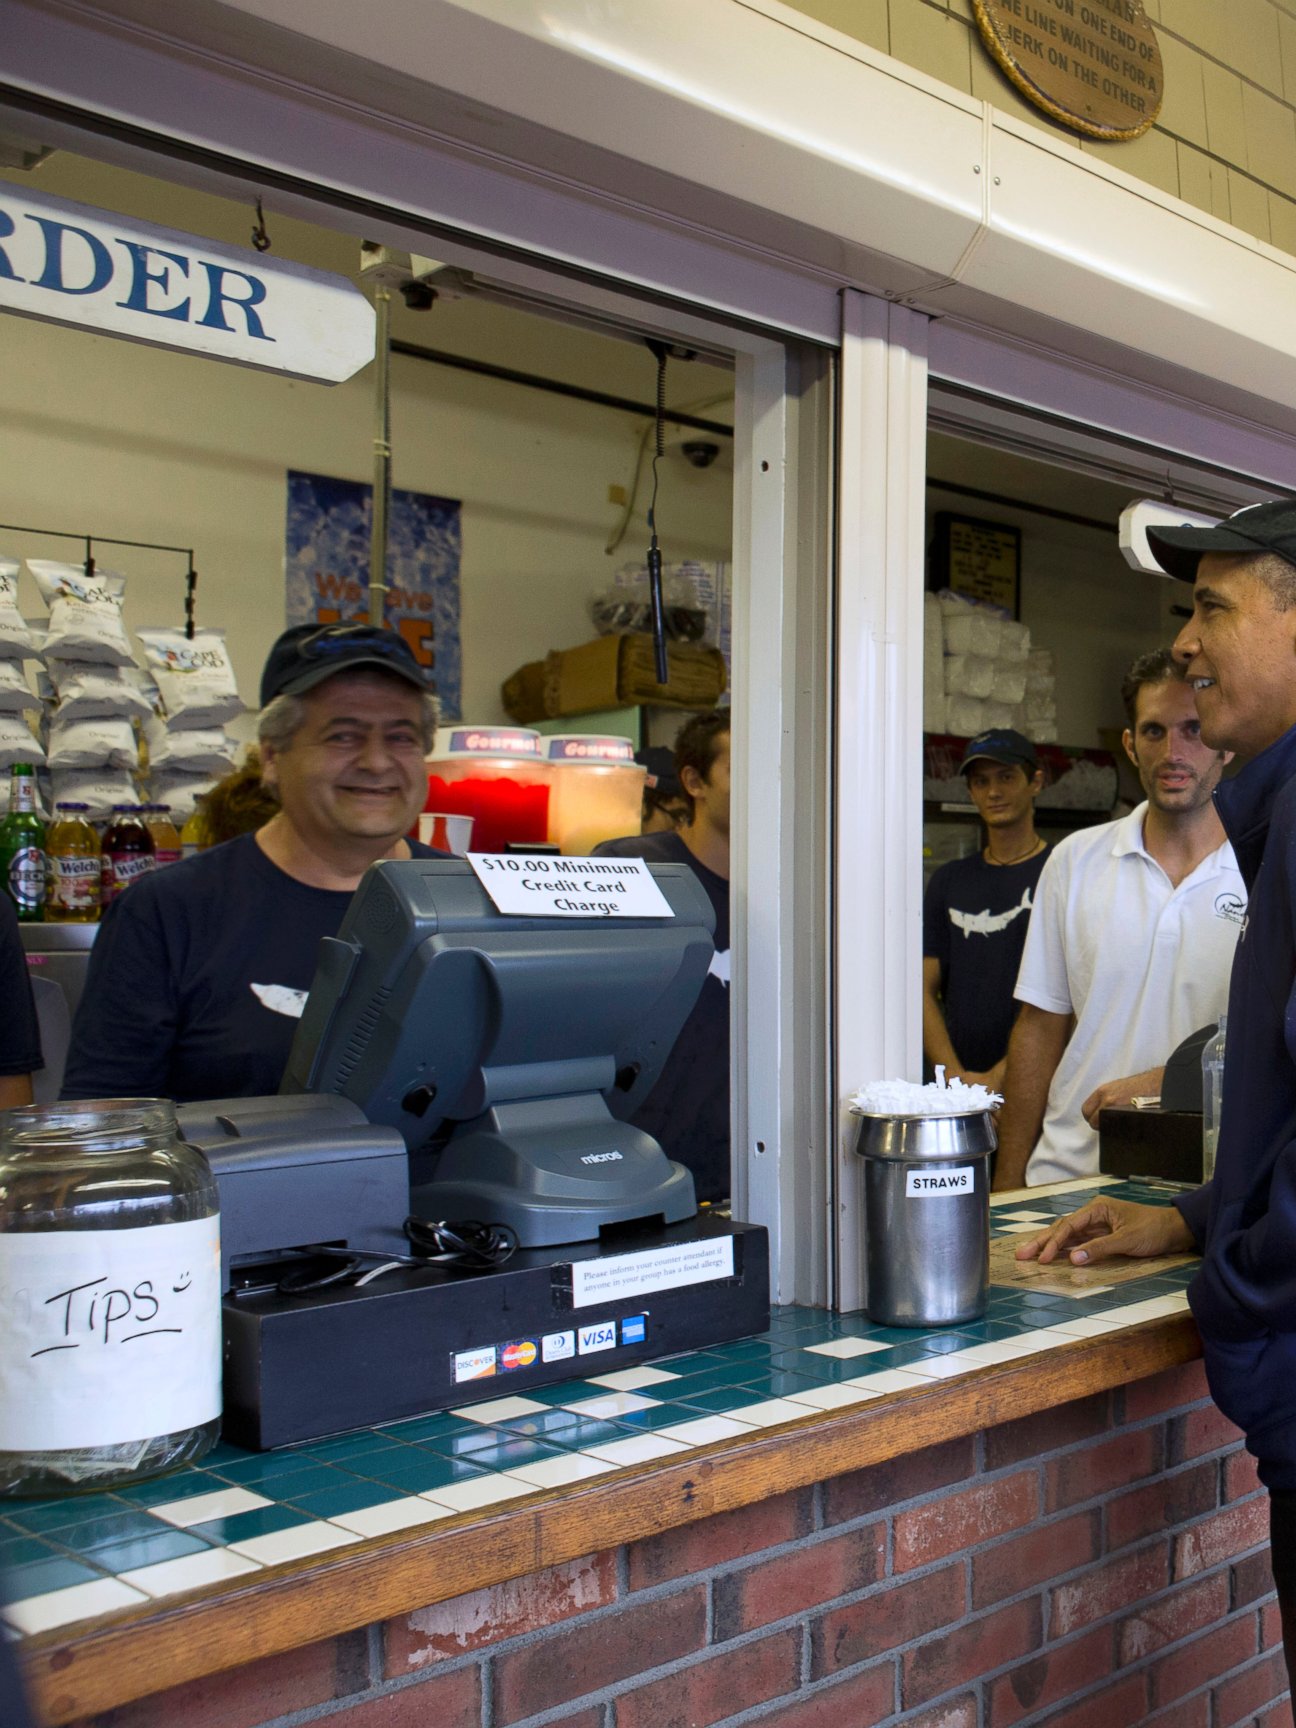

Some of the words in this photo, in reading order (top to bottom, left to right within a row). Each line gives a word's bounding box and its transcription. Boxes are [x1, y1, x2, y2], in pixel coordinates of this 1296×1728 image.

[1081, 7, 1107, 35] ONE
[1110, 24, 1136, 51] END
[1139, 42, 1155, 62] OF
[1025, 5, 1057, 37] LINE
[1061, 24, 1120, 72] WAITING
[1123, 60, 1146, 89] FOR
[1006, 24, 1044, 58] JERK
[1048, 48, 1068, 72] ON
[1073, 60, 1098, 88] THE
[1102, 78, 1146, 114] OTHER
[315, 572, 363, 603] We
[385, 588, 433, 611] ave
[482, 858, 550, 872] $10.00
[553, 860, 640, 874] Minimum
[522, 879, 580, 892] Credit
[585, 881, 627, 893] Card
[554, 899, 620, 914] Charge
[580, 1150, 623, 1165] micros
[913, 1175, 967, 1189] STRAWS
[584, 1271, 608, 1280] Please
[610, 1265, 635, 1276] inform
[636, 1262, 653, 1274] your
[654, 1256, 681, 1267] counter
[683, 1248, 715, 1261] attendant
[622, 1276, 639, 1286] your
[640, 1271, 662, 1282] group
[663, 1268, 676, 1276] has
[684, 1262, 699, 1272] food
[583, 1328, 614, 1346] VISA
